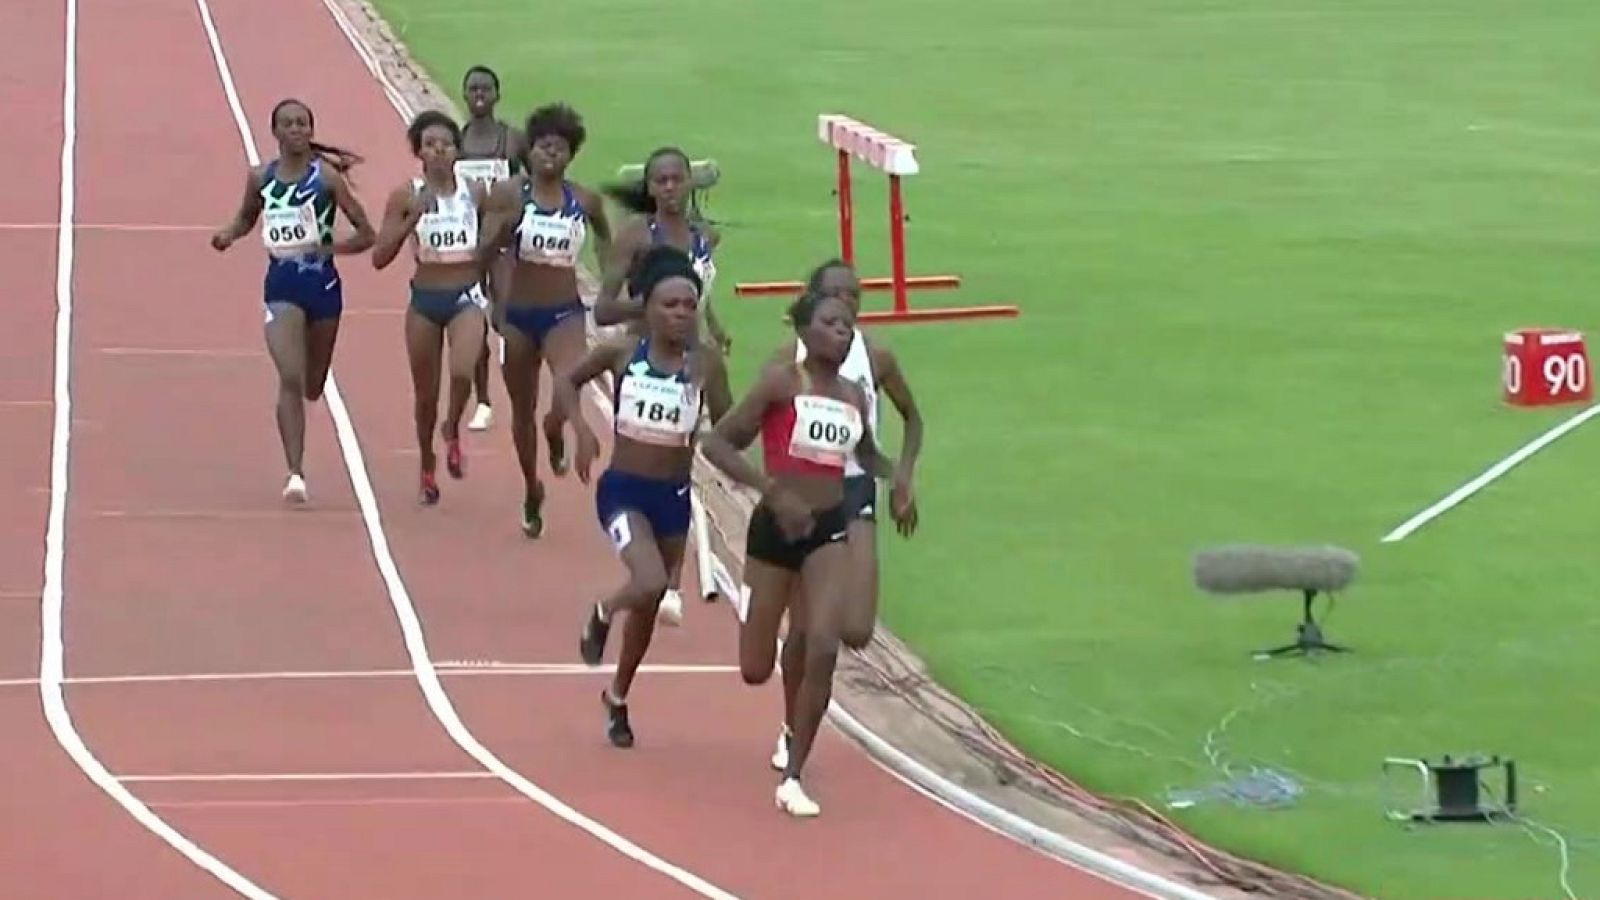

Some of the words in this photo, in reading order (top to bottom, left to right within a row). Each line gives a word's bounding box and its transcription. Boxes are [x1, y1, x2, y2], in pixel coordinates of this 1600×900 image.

[430, 230, 467, 247] 084
[1543, 352, 1586, 396] 90
[635, 399, 681, 424] 184
[809, 419, 851, 445] 009
